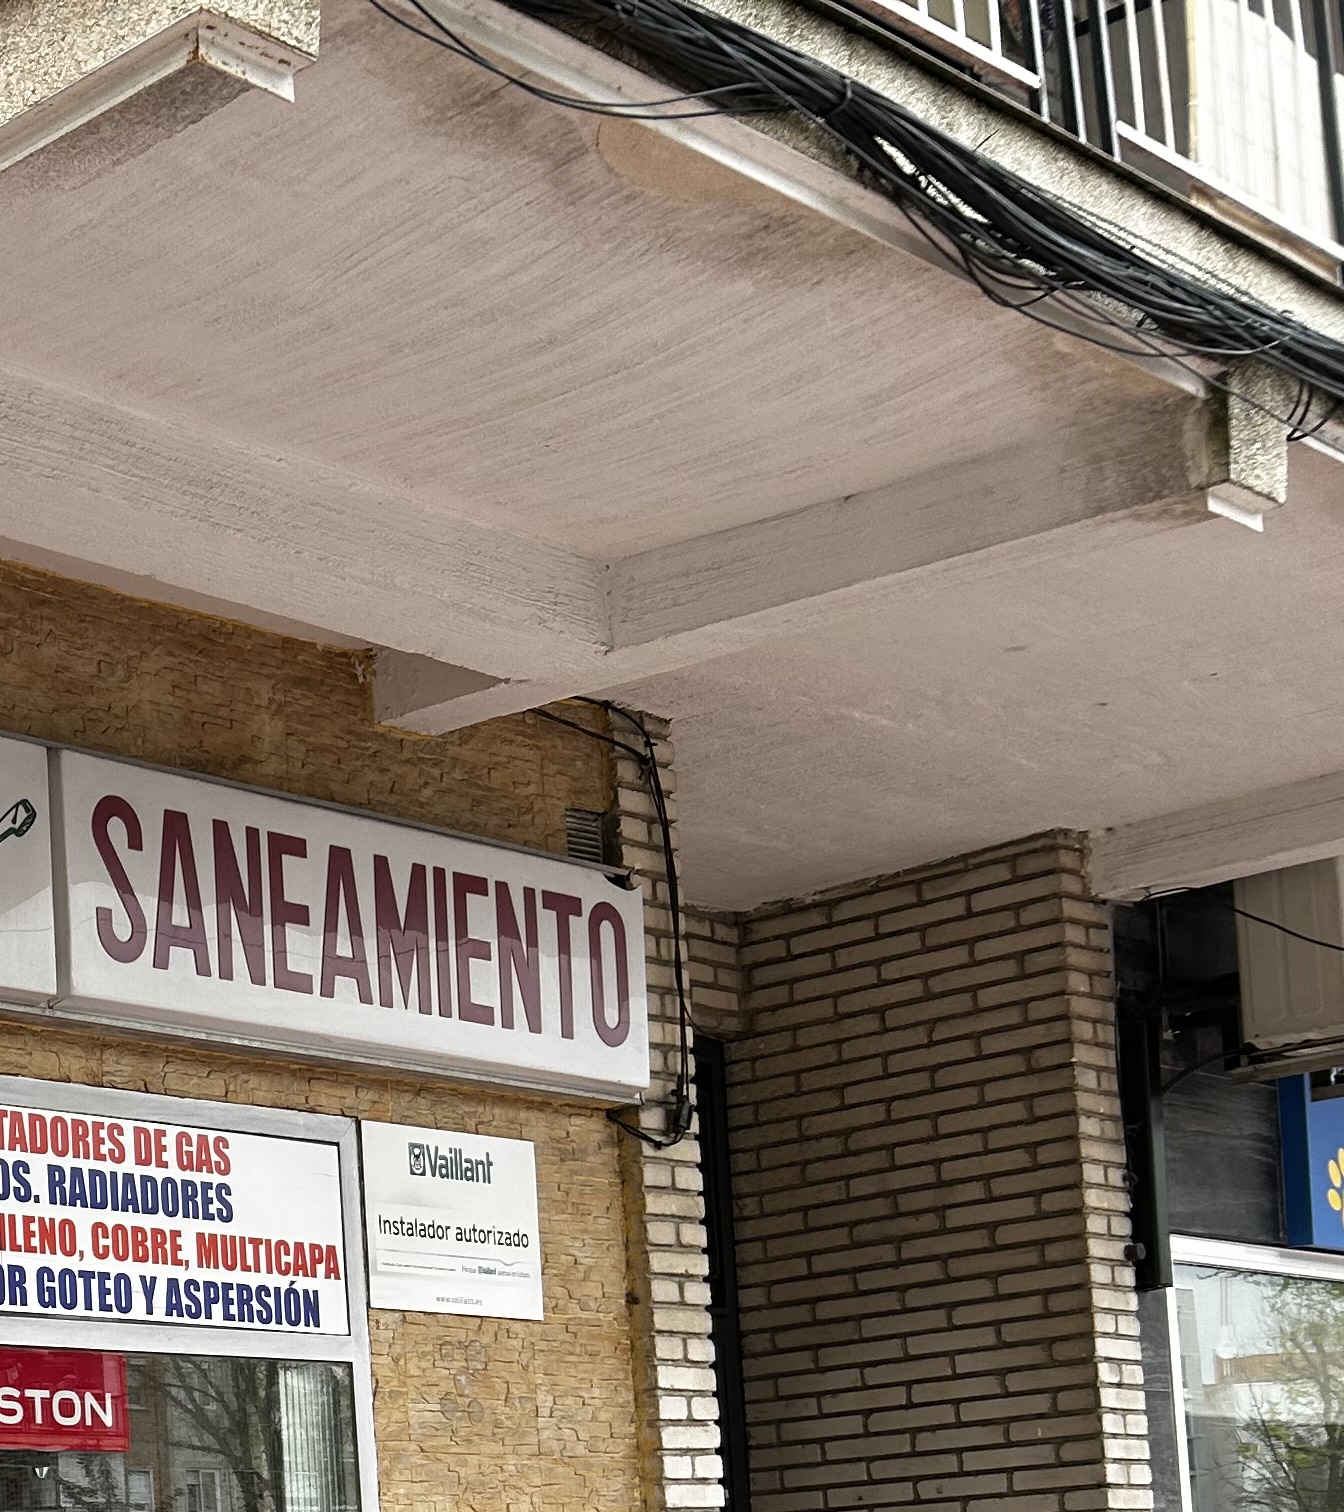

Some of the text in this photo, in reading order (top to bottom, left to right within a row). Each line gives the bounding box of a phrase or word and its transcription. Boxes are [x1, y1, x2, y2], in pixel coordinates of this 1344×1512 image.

[91, 794, 631, 1048] SANEAMIENTO
[133, 1126, 169, 1169] DE
[175, 1131, 231, 1176] GAS
[425, 1144, 494, 1184] Vaillant
[47, 1164, 234, 1223] RADIADORES
[90, 1221, 190, 1271] COBRE,
[195, 1231, 342, 1280] MULTICAPA
[377, 1213, 530, 1248] Instalador autorizado
[35, 1265, 133, 1315] GOTEO
[138, 1275, 158, 1315] Y
[164, 1277, 321, 1328] ASPERSIÓN
